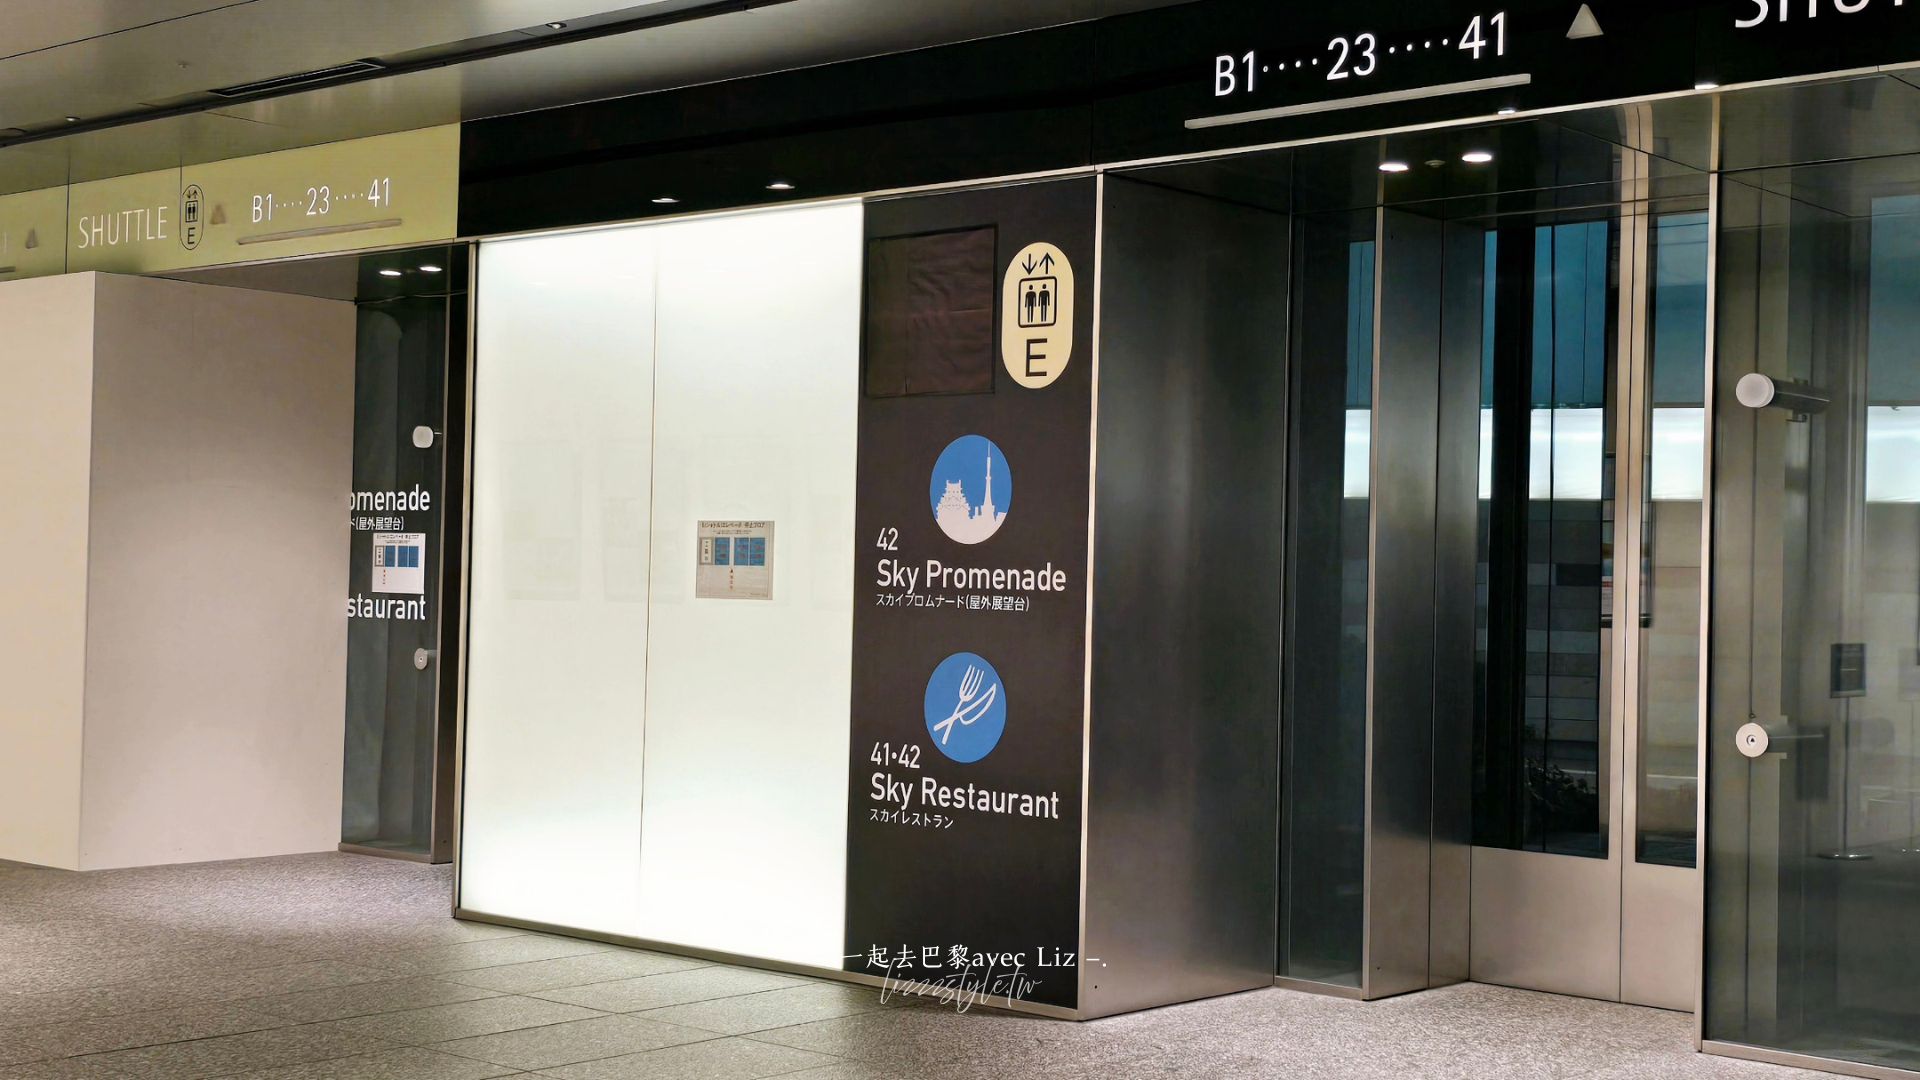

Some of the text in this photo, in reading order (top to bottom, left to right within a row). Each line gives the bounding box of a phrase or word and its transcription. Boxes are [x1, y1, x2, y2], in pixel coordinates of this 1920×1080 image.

[78, 206, 168, 249] SHUTTLE
[187, 226, 196, 245] E
[1025, 338, 1048, 377] E
[876, 527, 899, 551] 42
[876, 558, 1067, 594] Sky Promenade
[870, 772, 1060, 820] Sky Restaurant
[869, 808, 955, 829] スカイレストラン
